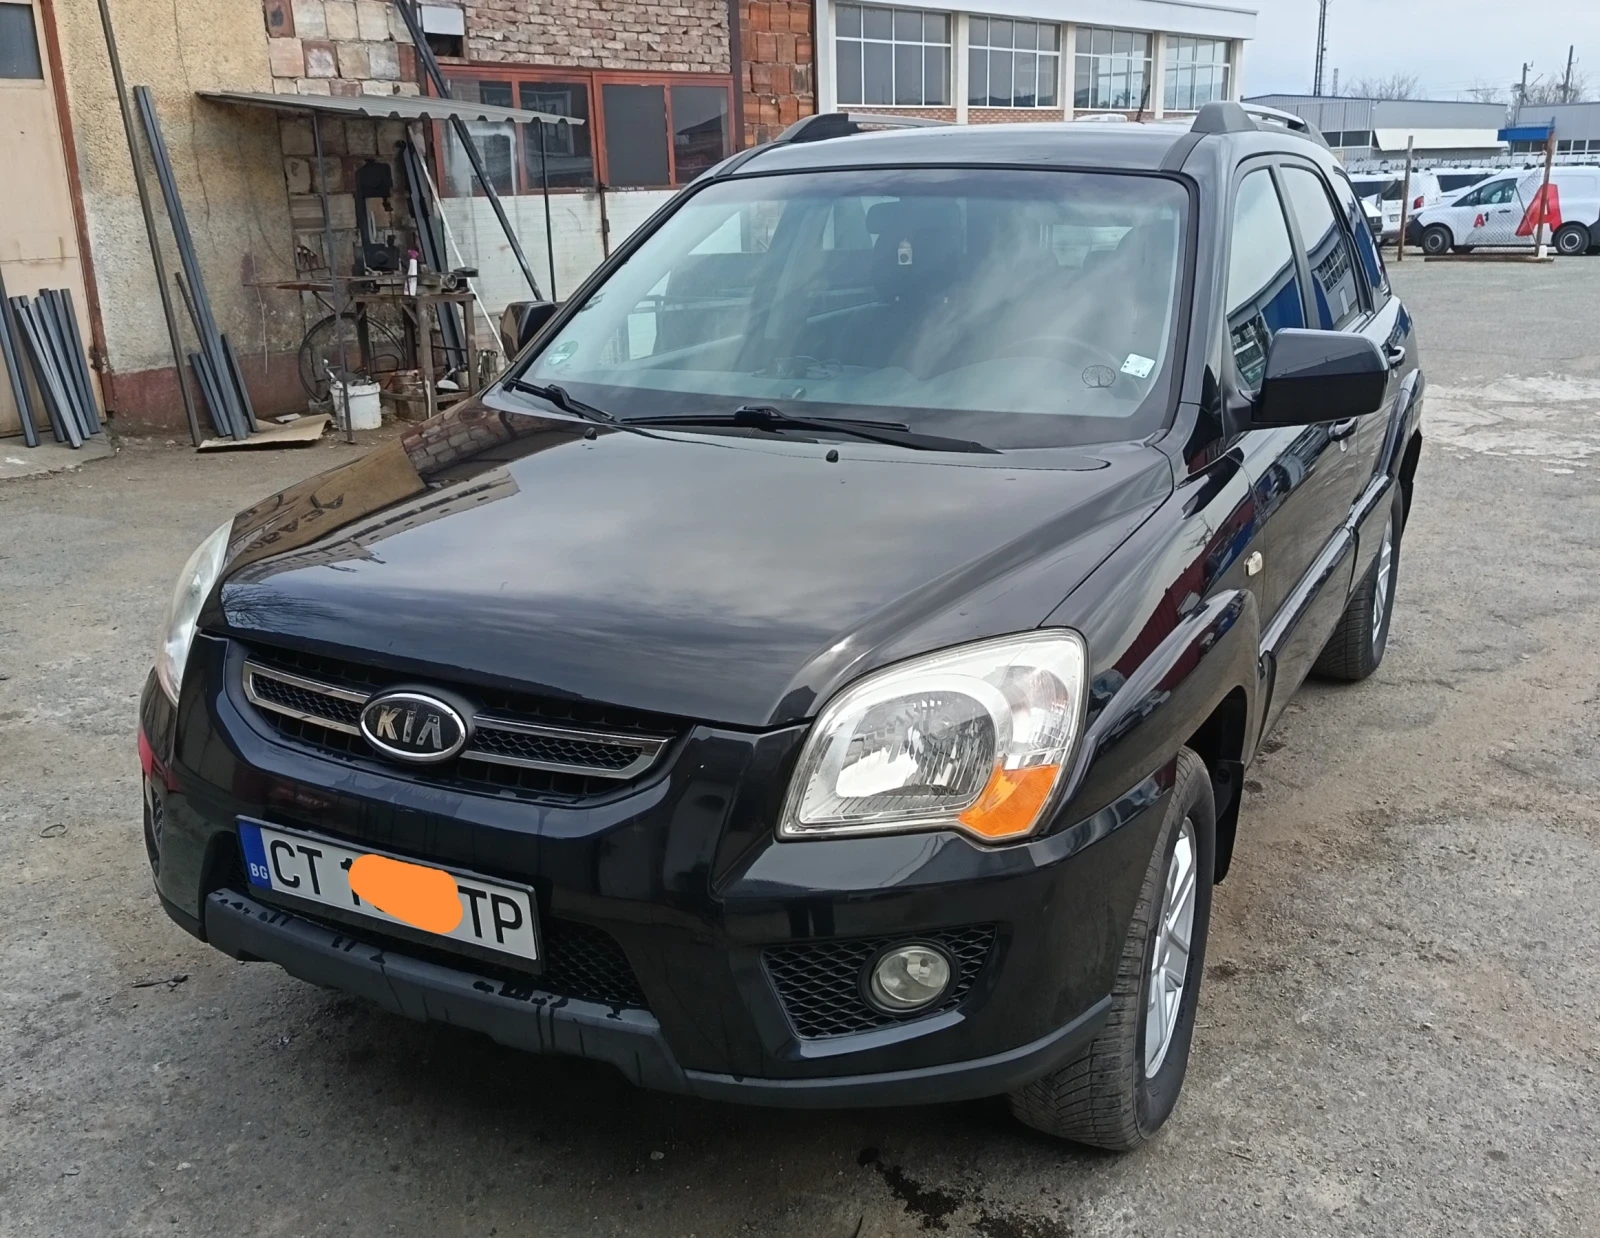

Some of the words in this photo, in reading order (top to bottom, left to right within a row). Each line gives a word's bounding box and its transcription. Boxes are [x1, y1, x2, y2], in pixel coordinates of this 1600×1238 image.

[1473, 211, 1489, 228] A1
[376, 704, 443, 750] KIA
[250, 862, 269, 881] BG
[269, 838, 323, 896] CT
[457, 884, 524, 944] TP
